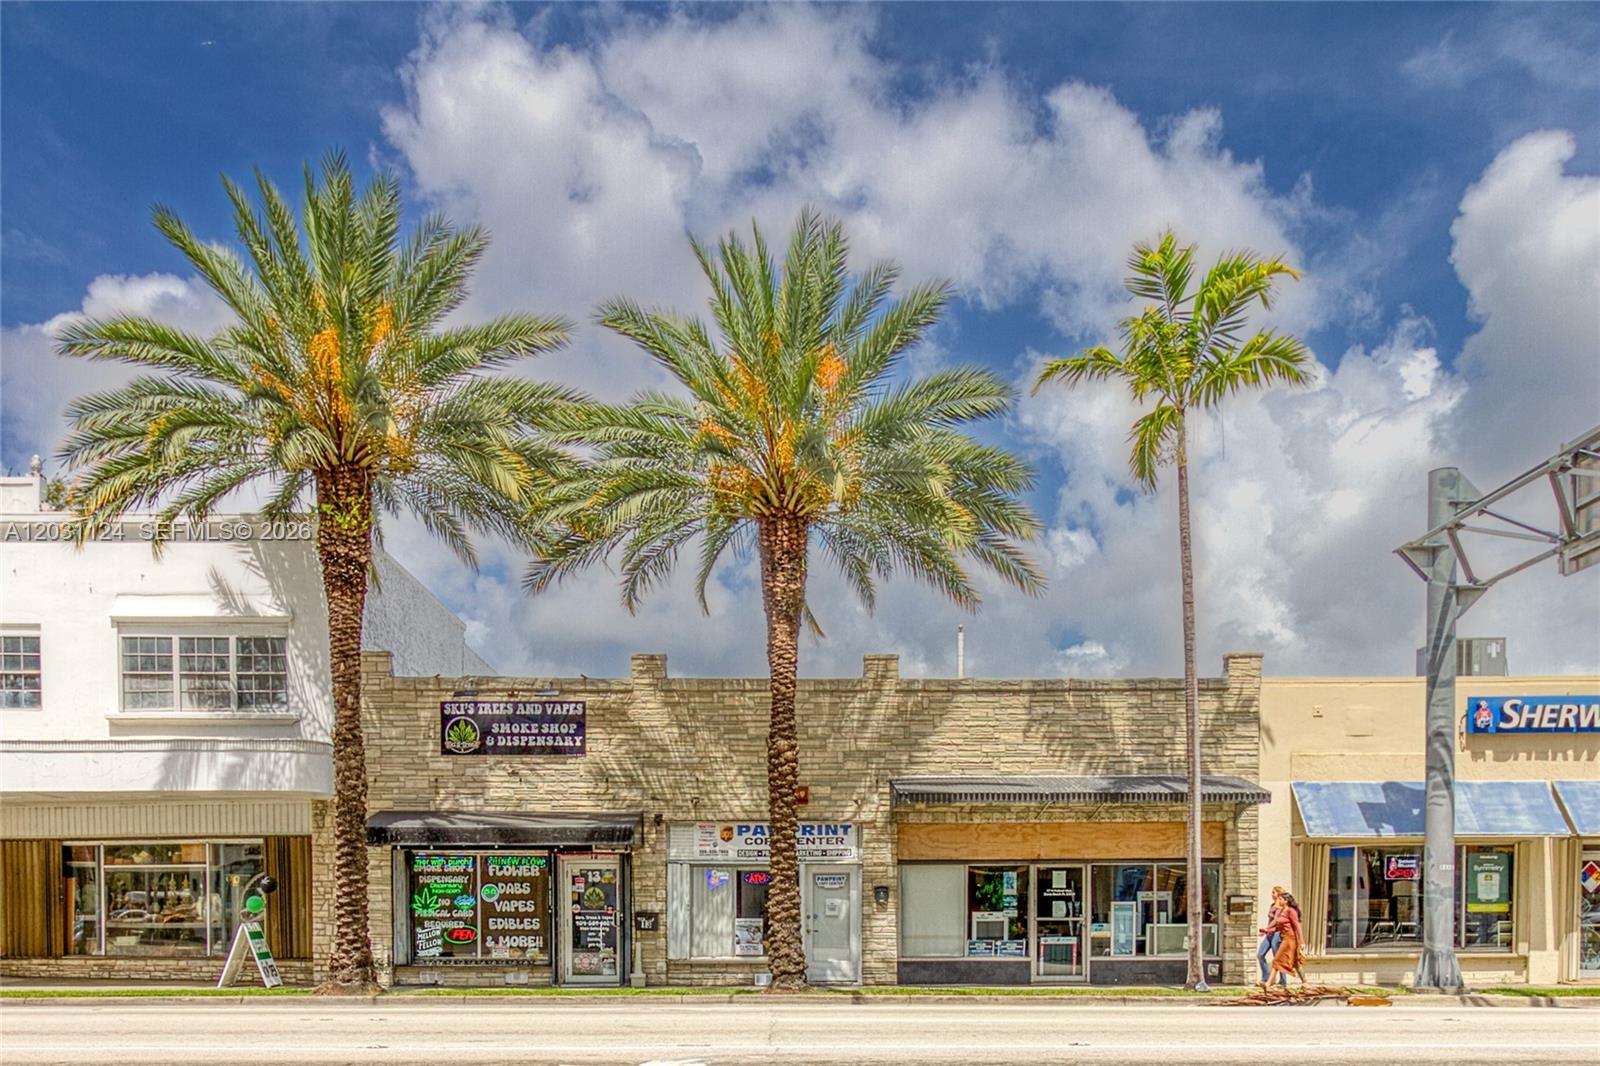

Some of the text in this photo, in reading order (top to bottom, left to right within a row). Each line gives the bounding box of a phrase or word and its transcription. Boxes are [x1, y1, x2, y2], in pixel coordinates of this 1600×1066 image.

[444, 703, 584, 715] SKI'S TREES AND VAPES
[1499, 699, 1600, 729] SHERW
[491, 723, 577, 734] SMOKE SHOP
[485, 736, 494, 746] &
[497, 736, 583, 746] DISPENSARY
[737, 824, 852, 836] PARINT
[744, 837, 845, 845] COP ENTER
[488, 864, 540, 876] FLOWER
[419, 875, 469, 883] DISPENSARY
[587, 870, 601, 883] 13
[749, 872, 767, 884] ATM
[497, 882, 531, 894] DABS
[438, 898, 451, 906] NO
[494, 900, 536, 912] VAPES
[452, 909, 474, 917] CARD
[424, 920, 465, 928] REQUIRED
[488, 918, 541, 930] EDIBLES
[449, 929, 476, 940] PEN
[485, 936, 544, 948] & MORE!!
